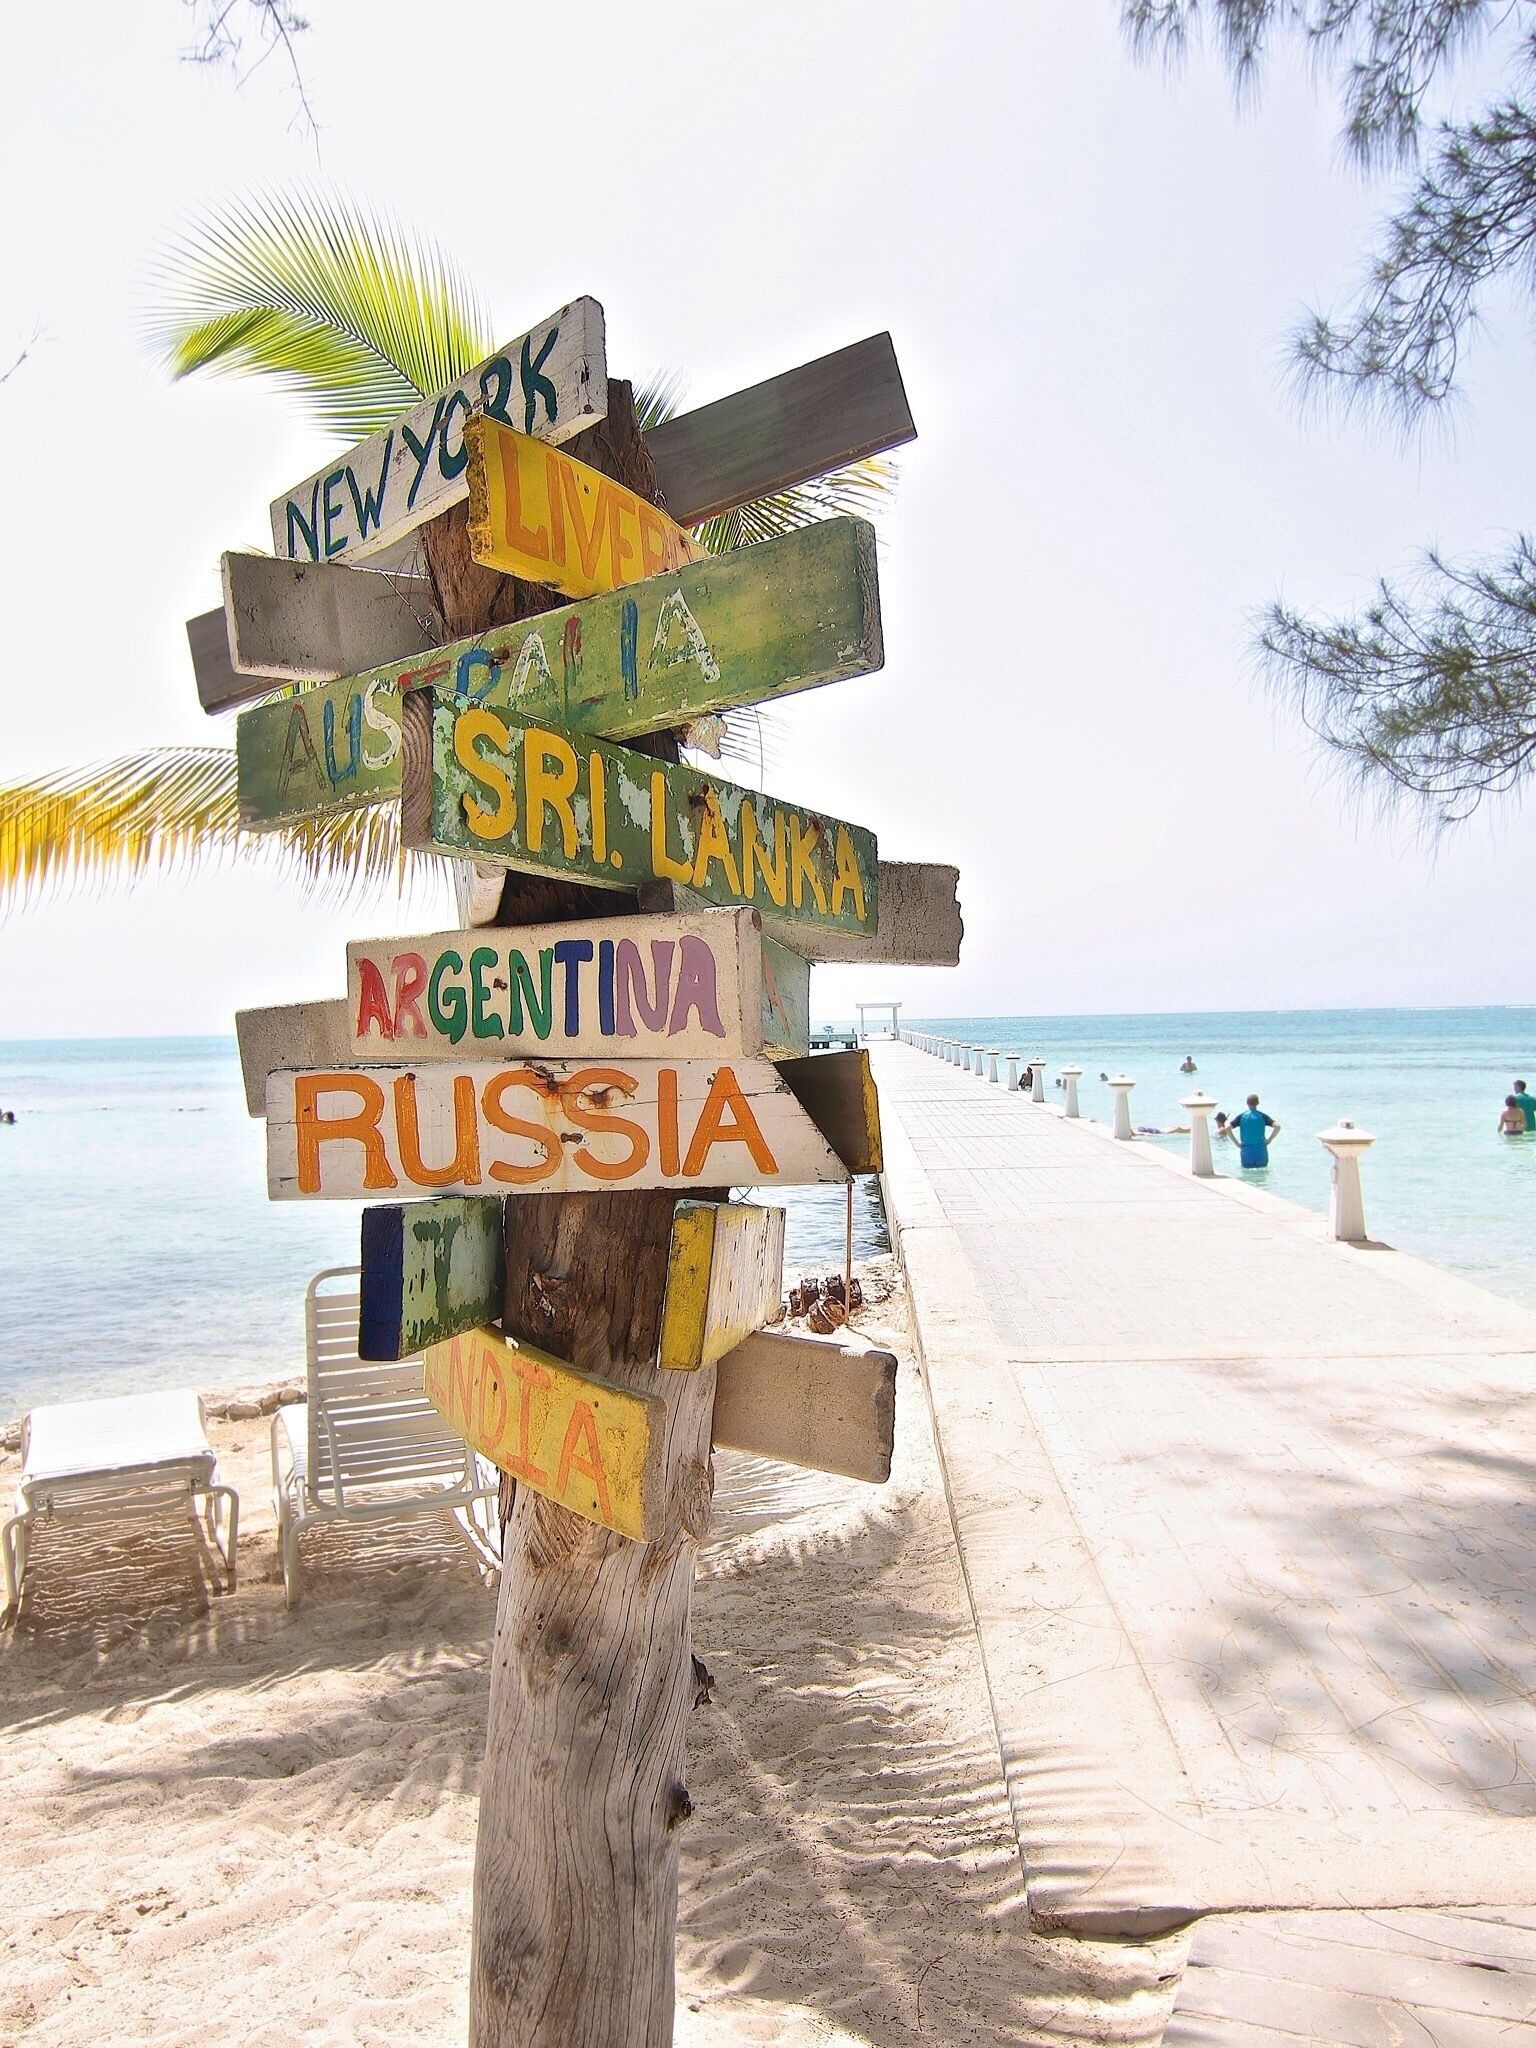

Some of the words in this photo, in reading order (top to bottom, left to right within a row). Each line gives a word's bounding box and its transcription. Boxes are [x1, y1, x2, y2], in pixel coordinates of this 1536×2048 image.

[284, 430, 393, 562] NEW
[402, 327, 558, 511] YORK
[454, 708, 623, 870] SRI.
[651, 771, 865, 921] LANKA
[356, 935, 727, 1042] ARGENTINA
[295, 1067, 780, 1194] RUSSIA
